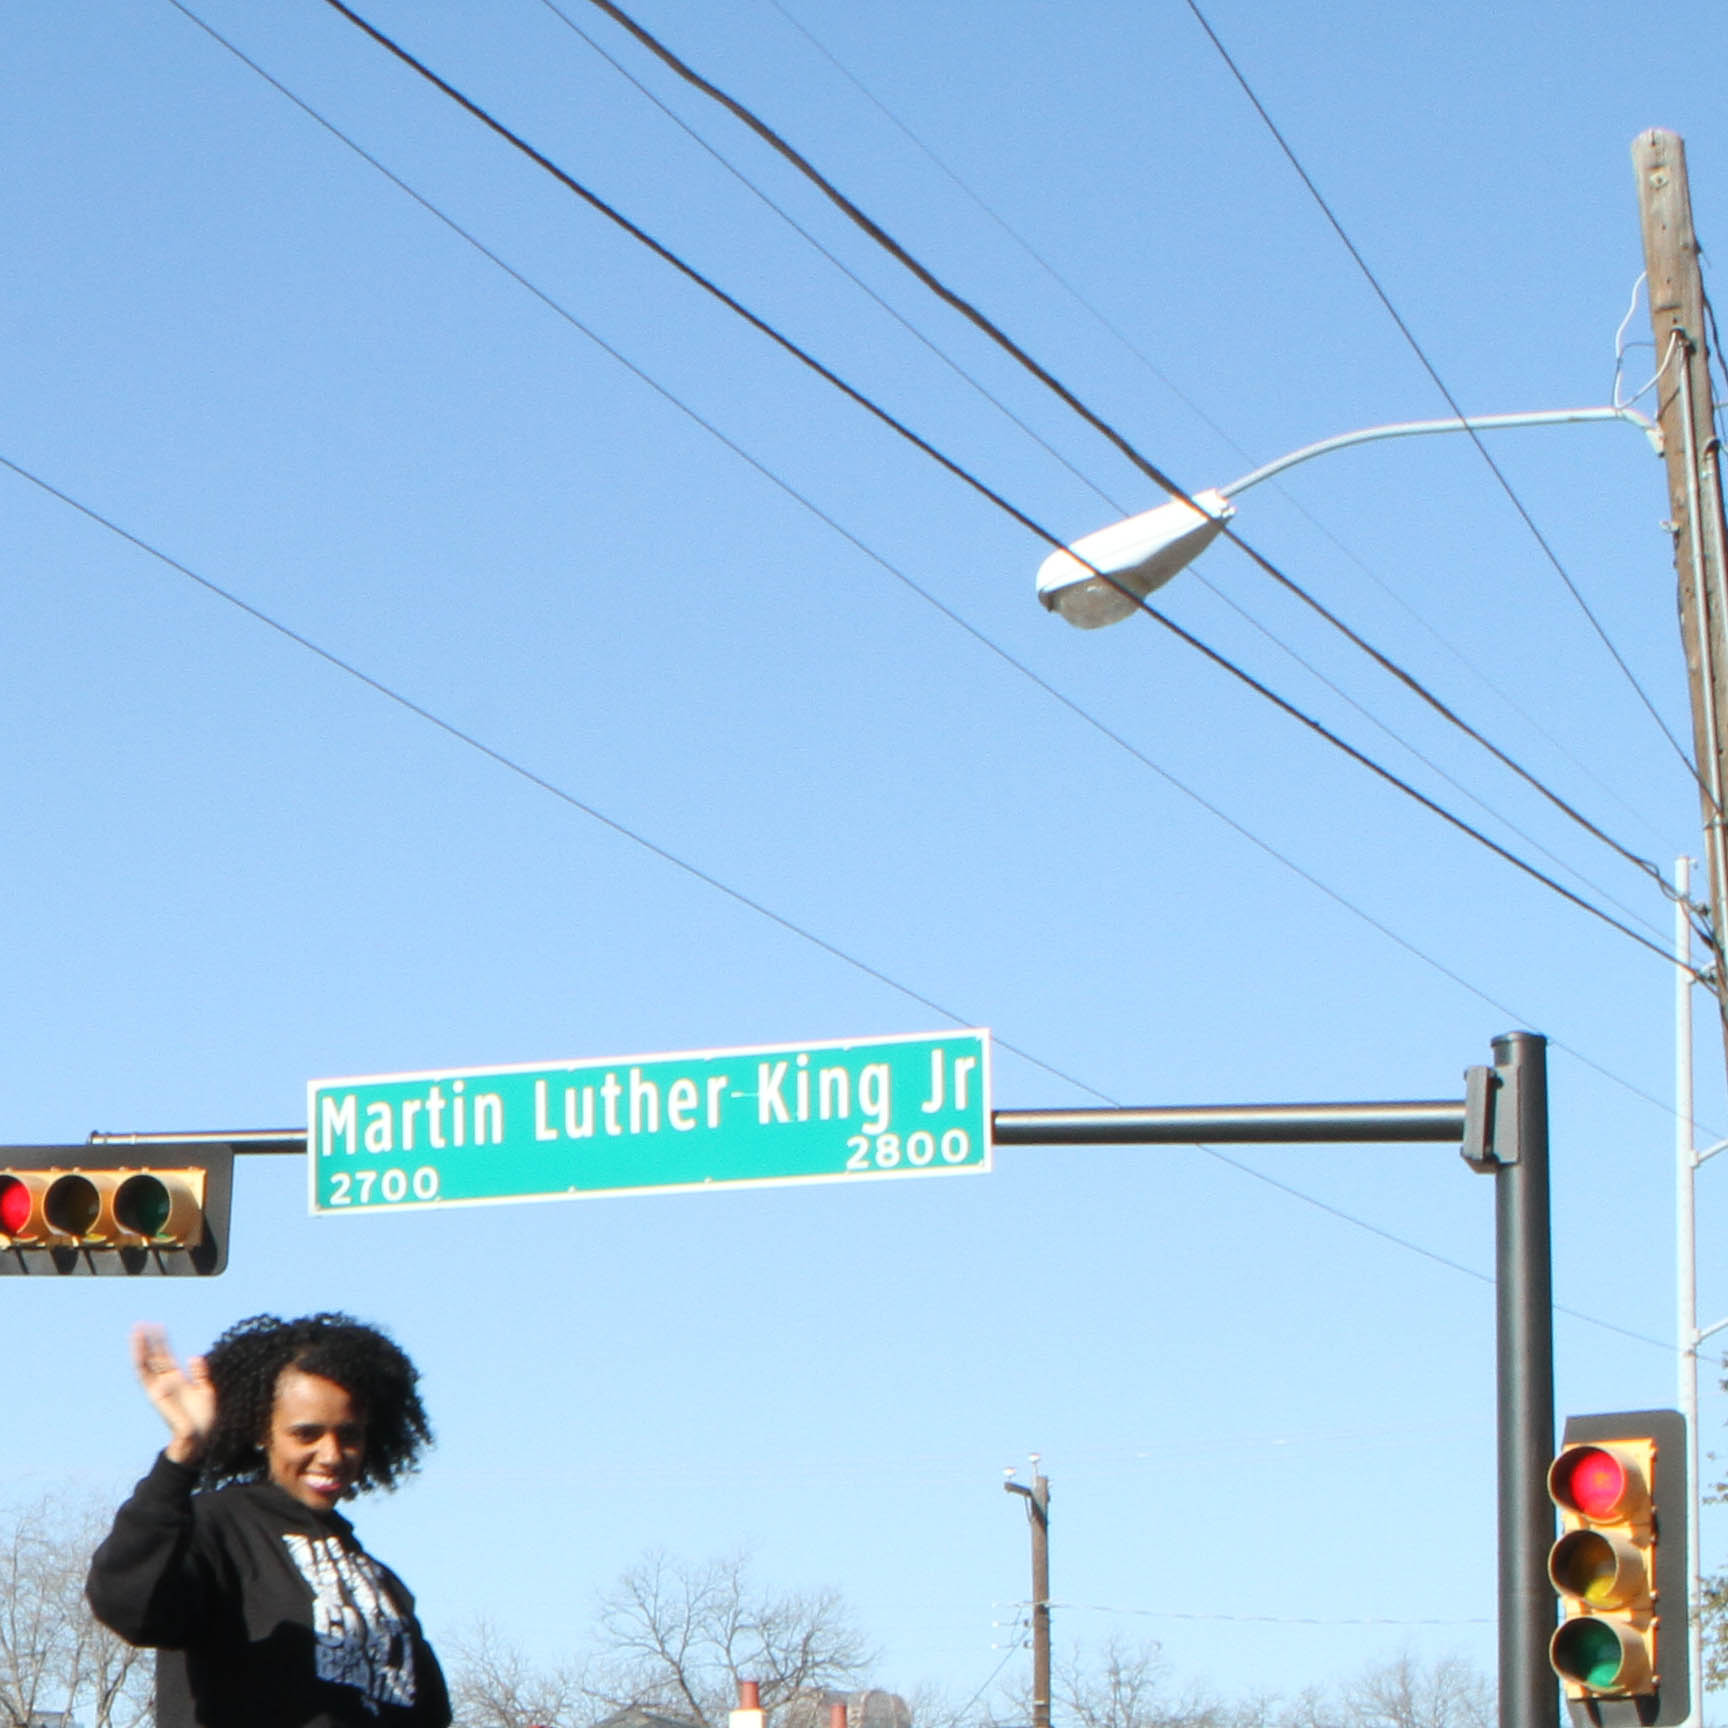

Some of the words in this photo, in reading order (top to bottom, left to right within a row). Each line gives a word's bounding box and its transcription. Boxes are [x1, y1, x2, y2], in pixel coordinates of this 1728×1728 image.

[321, 1079, 504, 1157] Martin
[534, 1066, 731, 1143] Luther
[757, 1053, 890, 1135] King
[921, 1047, 976, 1114] Jr
[845, 1127, 970, 1171] 2800
[328, 1165, 440, 1207] 2700
